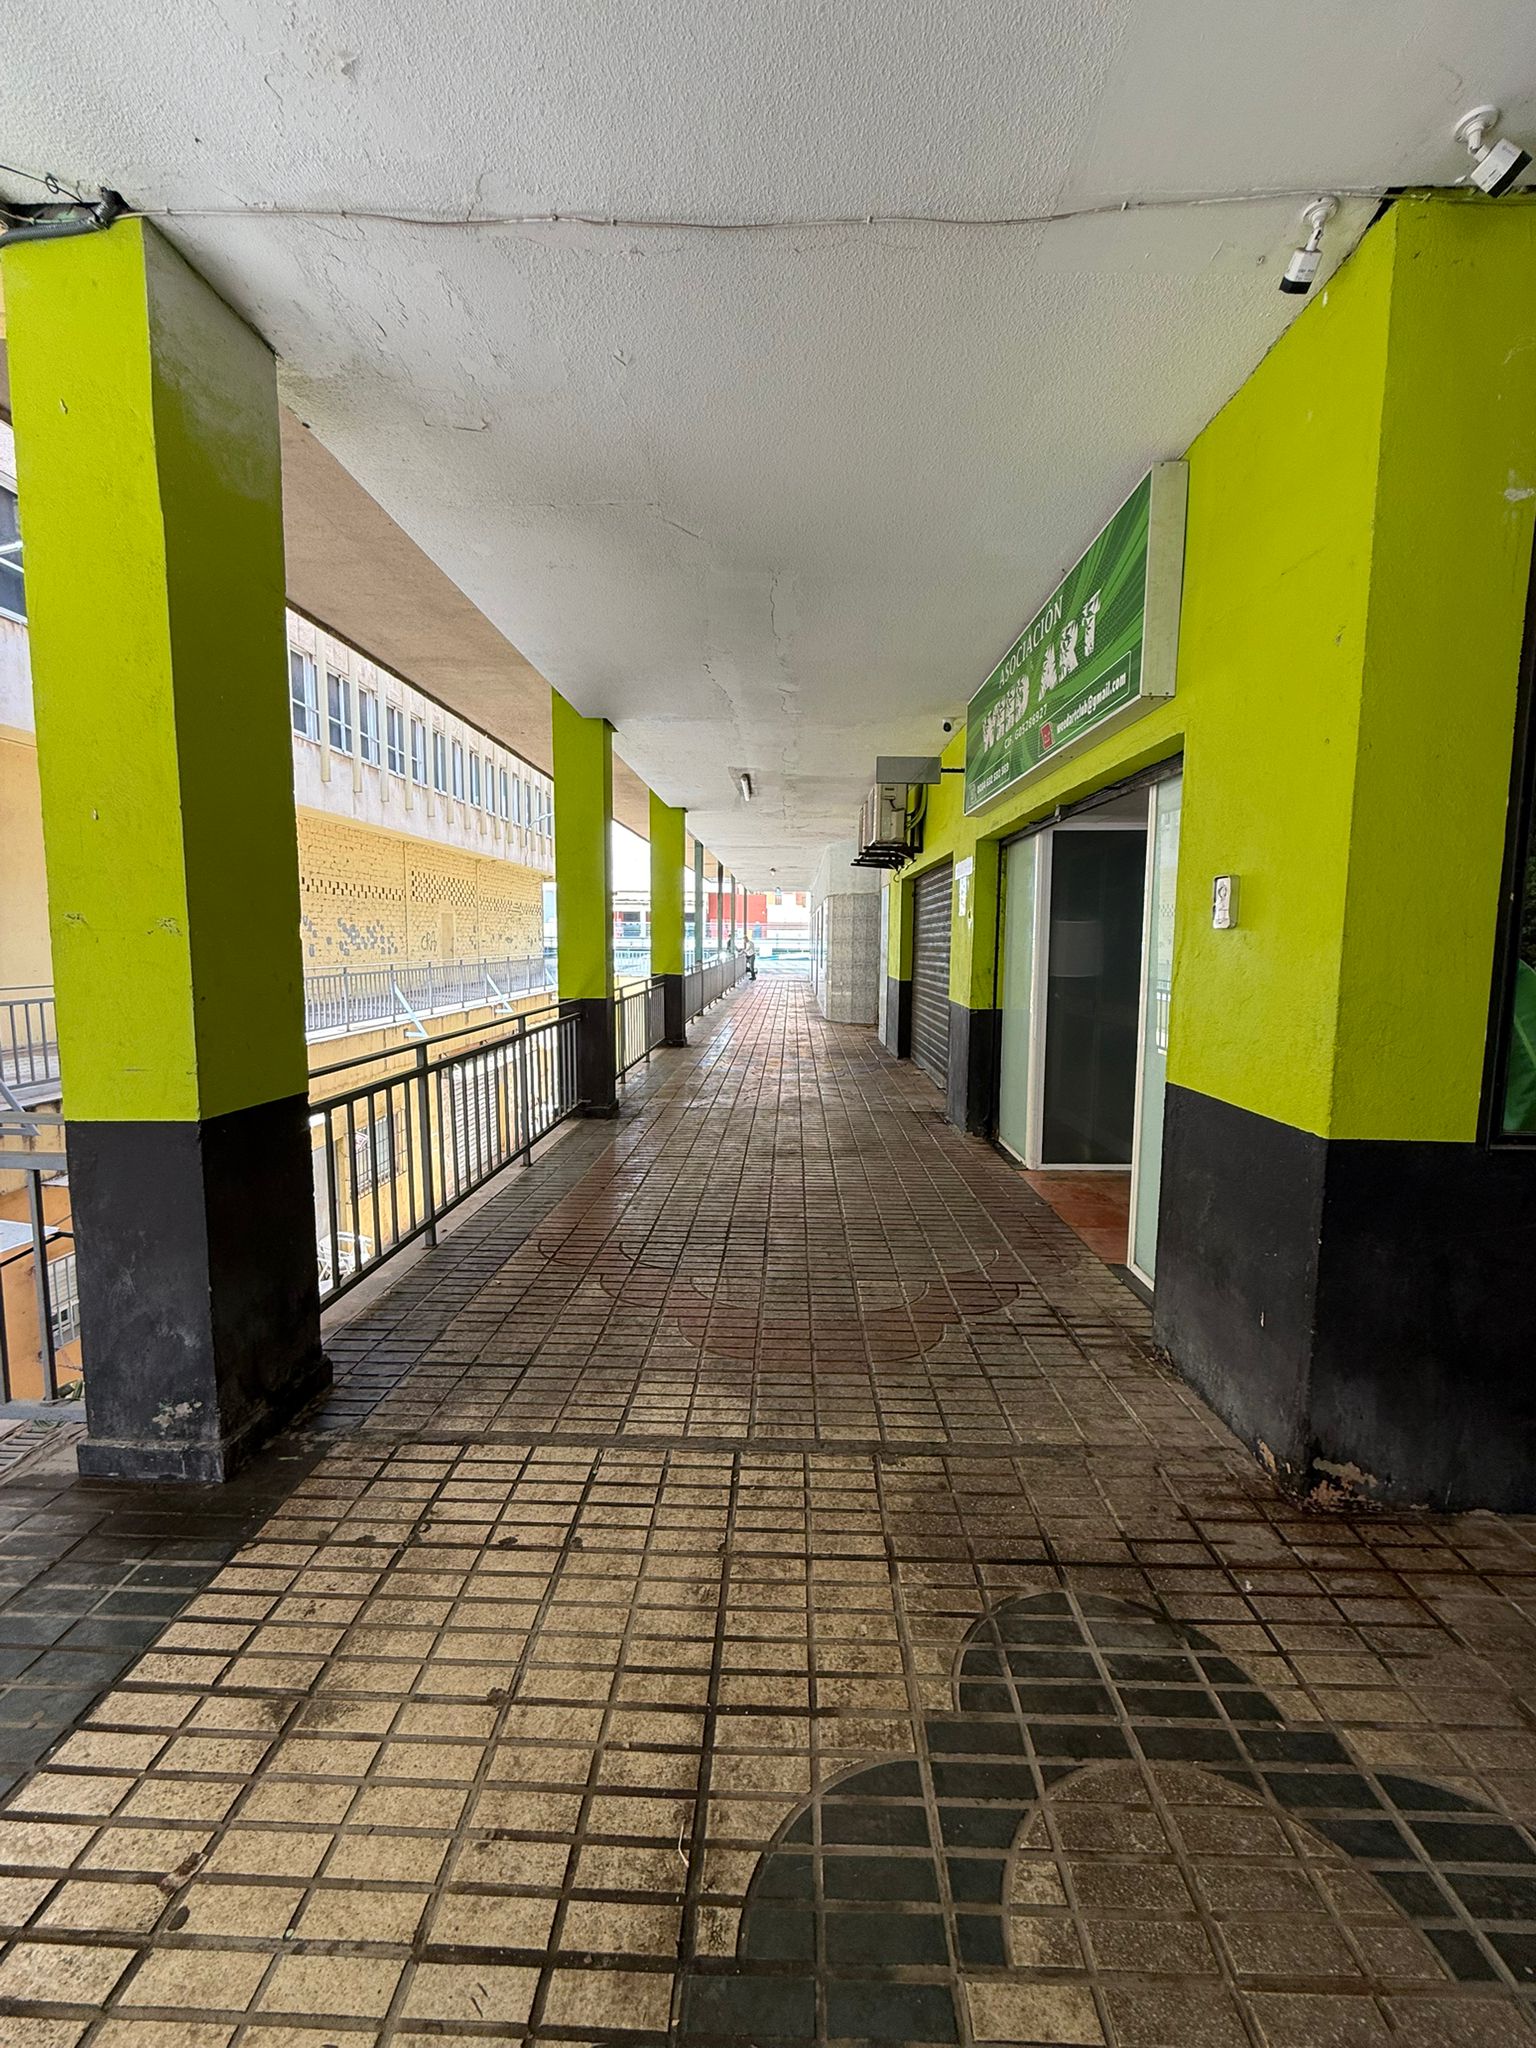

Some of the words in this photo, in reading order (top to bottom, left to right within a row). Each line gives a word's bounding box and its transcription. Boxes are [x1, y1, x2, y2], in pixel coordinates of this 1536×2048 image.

[983, 674, 1030, 753] WEED
[1038, 588, 1102, 701] ART
[999, 595, 1064, 689] ASOCIACIÓN
